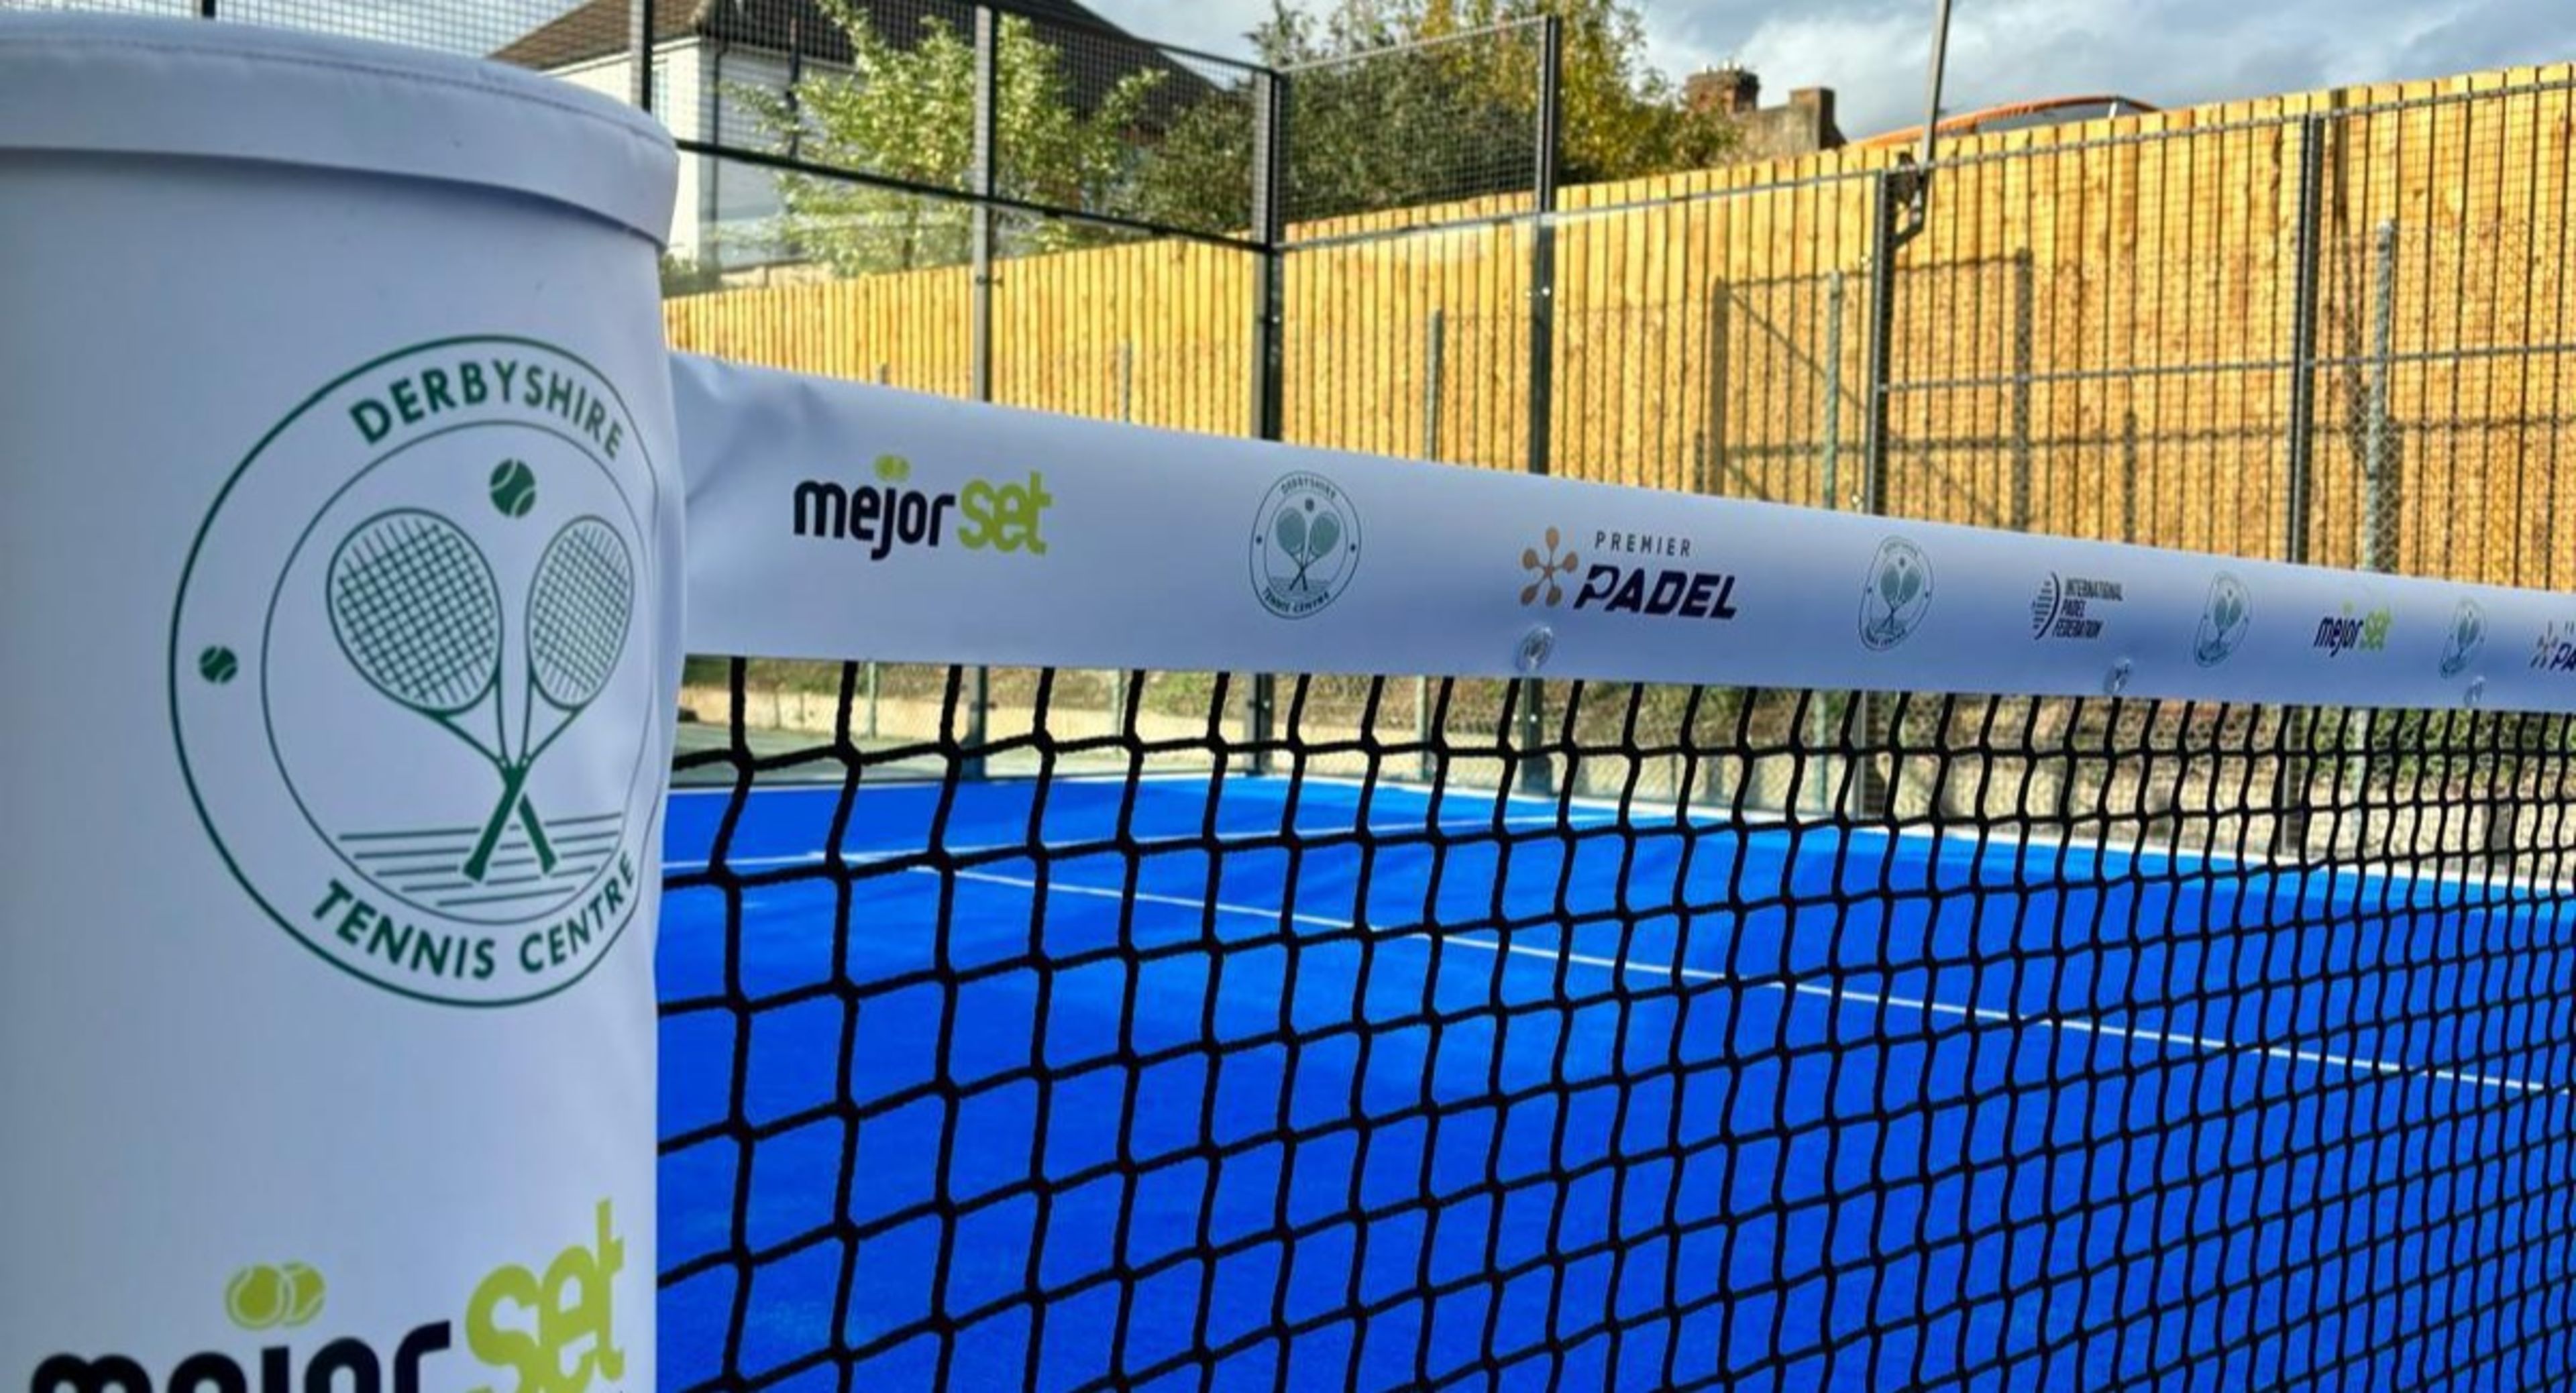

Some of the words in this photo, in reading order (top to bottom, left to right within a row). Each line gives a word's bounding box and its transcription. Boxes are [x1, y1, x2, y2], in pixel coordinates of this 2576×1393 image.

[349, 359, 623, 461] DERBYSHIRE
[1595, 530, 1691, 557] PREMIER
[1574, 563, 1737, 620] PADEL
[312, 879, 496, 981] TENNIS
[518, 848, 636, 974] CENTRE
